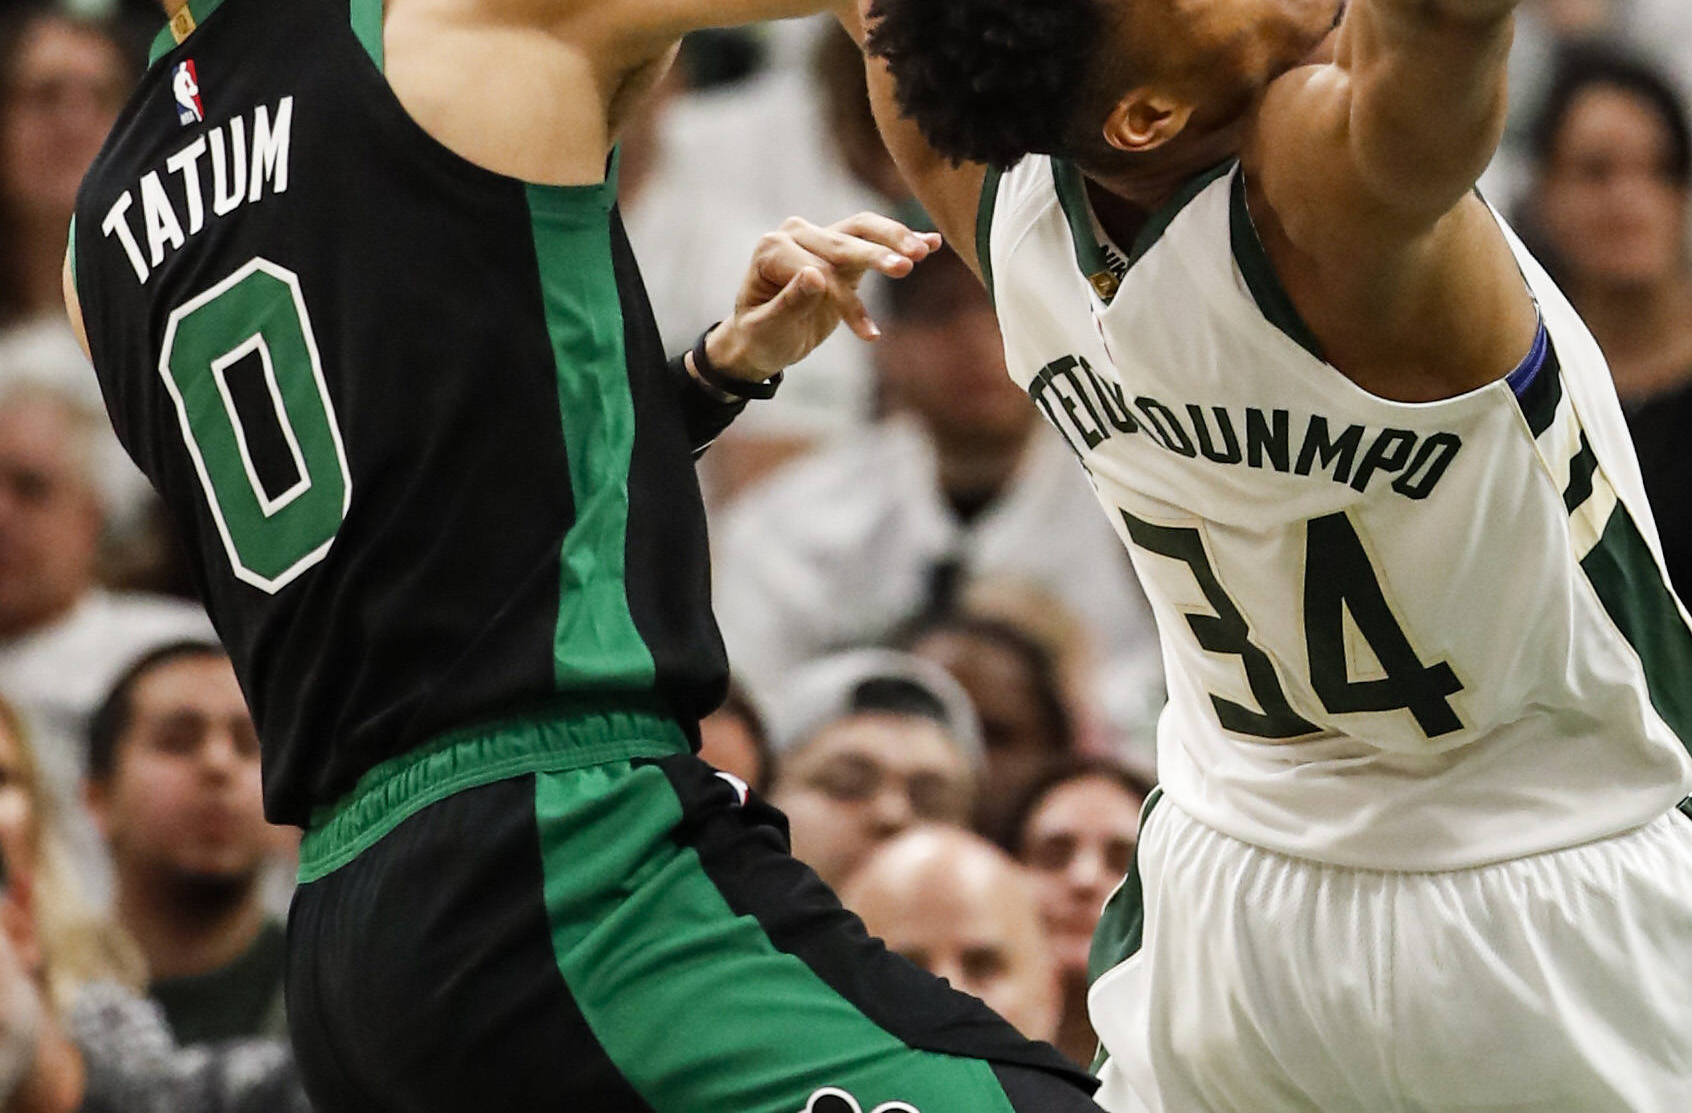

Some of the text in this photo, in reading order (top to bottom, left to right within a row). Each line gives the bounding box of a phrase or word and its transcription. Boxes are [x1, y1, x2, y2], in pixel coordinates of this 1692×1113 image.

[102, 95, 293, 285] TATUM
[1100, 244, 1128, 282] NIK
[158, 256, 353, 596] 0
[1119, 510, 1465, 738] 34
